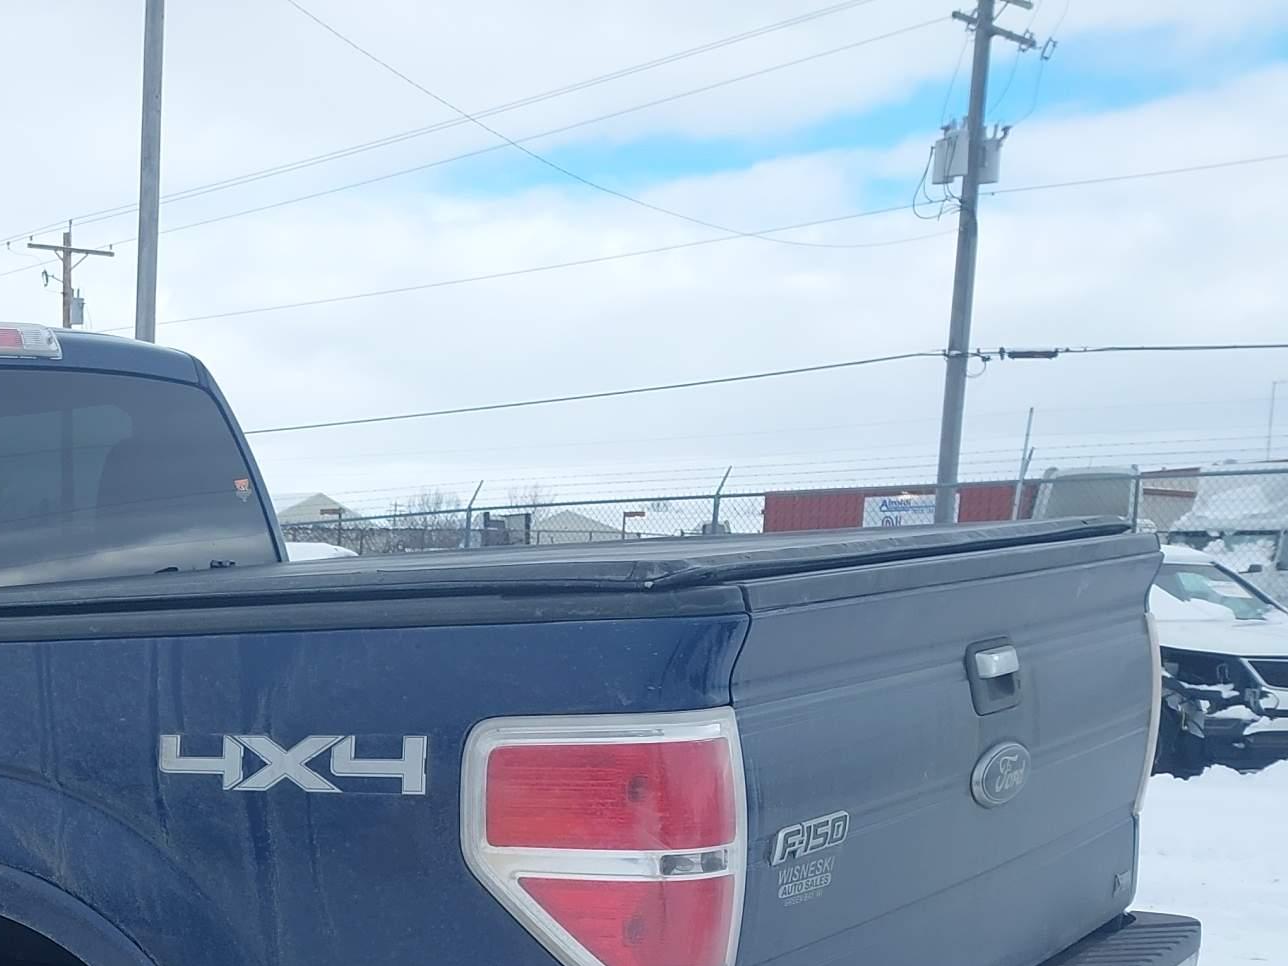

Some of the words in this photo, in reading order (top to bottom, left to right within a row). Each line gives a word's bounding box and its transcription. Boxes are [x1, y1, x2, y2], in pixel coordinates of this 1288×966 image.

[995, 754, 1027, 793] Ford
[778, 855, 836, 885] WISNESKI
[781, 882, 803, 897] AUTO
[804, 876, 830, 889] SALES
